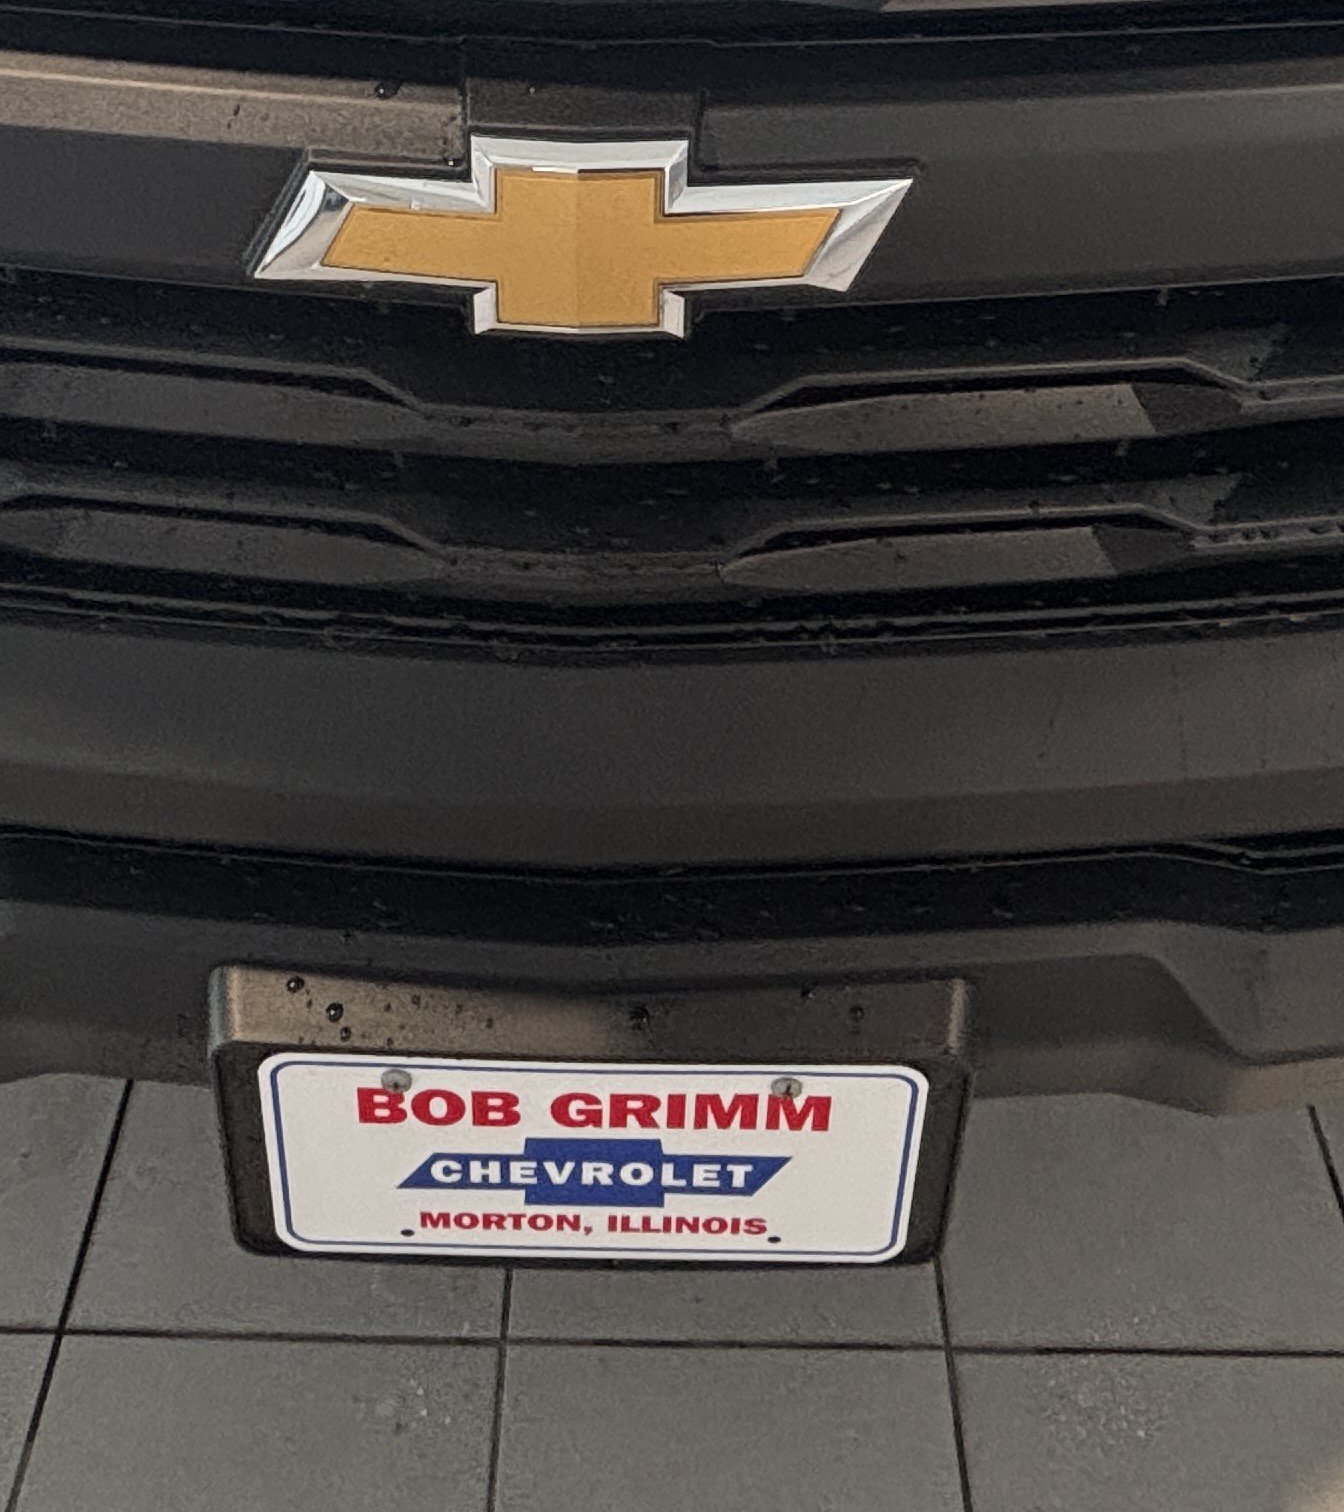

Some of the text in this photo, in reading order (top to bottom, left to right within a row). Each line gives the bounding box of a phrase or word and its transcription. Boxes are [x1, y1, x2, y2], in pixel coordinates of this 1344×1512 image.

[356, 1087, 832, 1131] BOB GRIMM
[430, 1159, 754, 1188] CHEVROLET
[420, 1211, 768, 1236] MORTON, ILLINOIS
